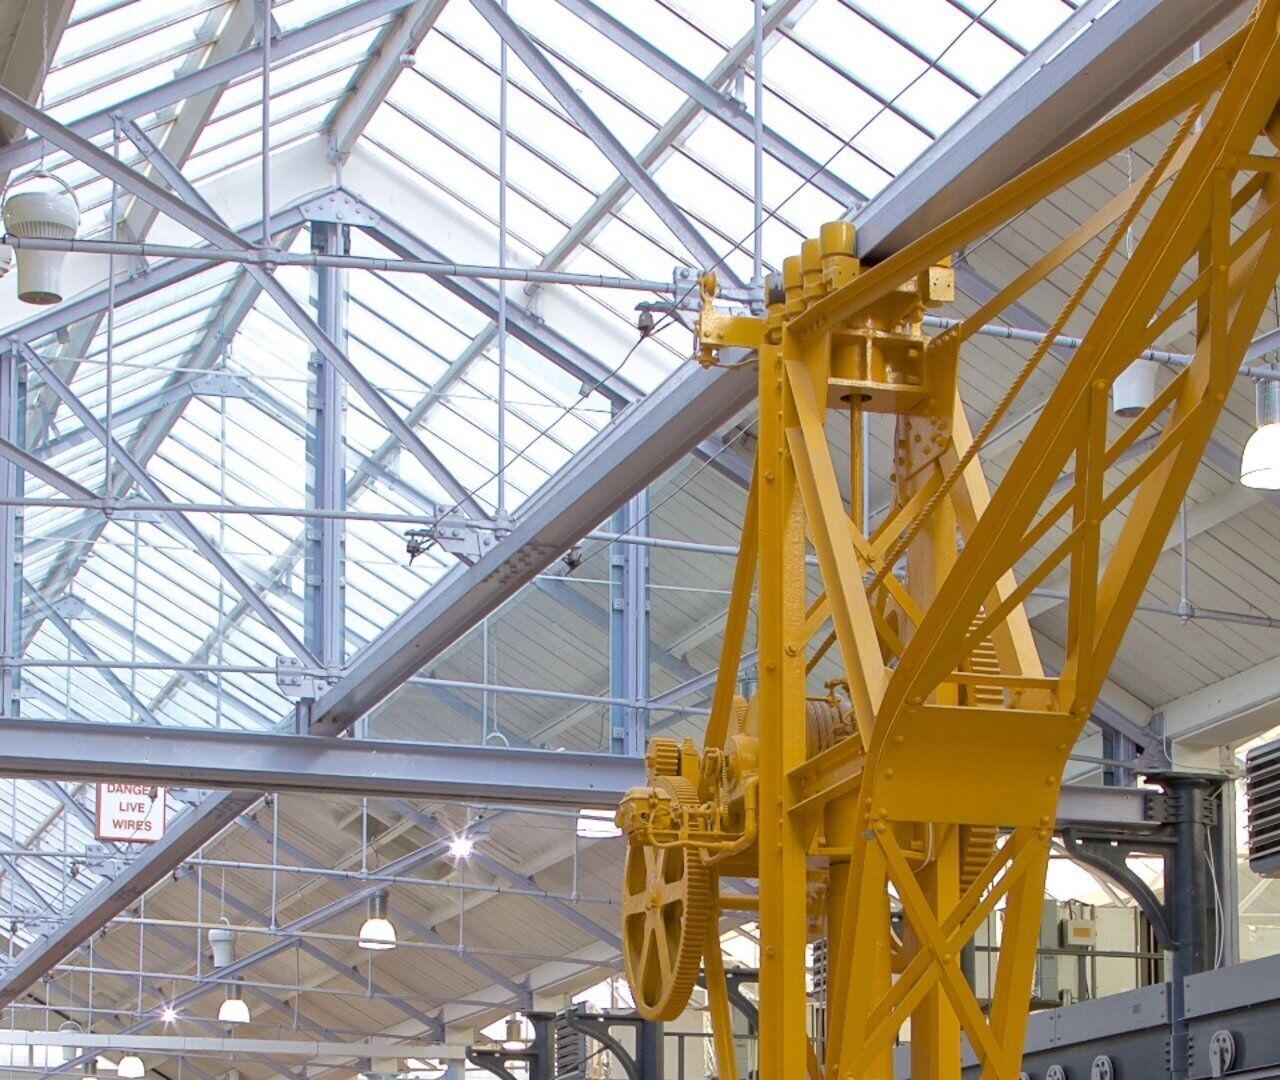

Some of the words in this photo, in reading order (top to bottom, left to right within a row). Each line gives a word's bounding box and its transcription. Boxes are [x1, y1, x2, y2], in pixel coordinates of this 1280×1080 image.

[108, 784, 150, 795] DANGE
[119, 802, 145, 813] LIVE
[112, 819, 152, 831] WIRES
